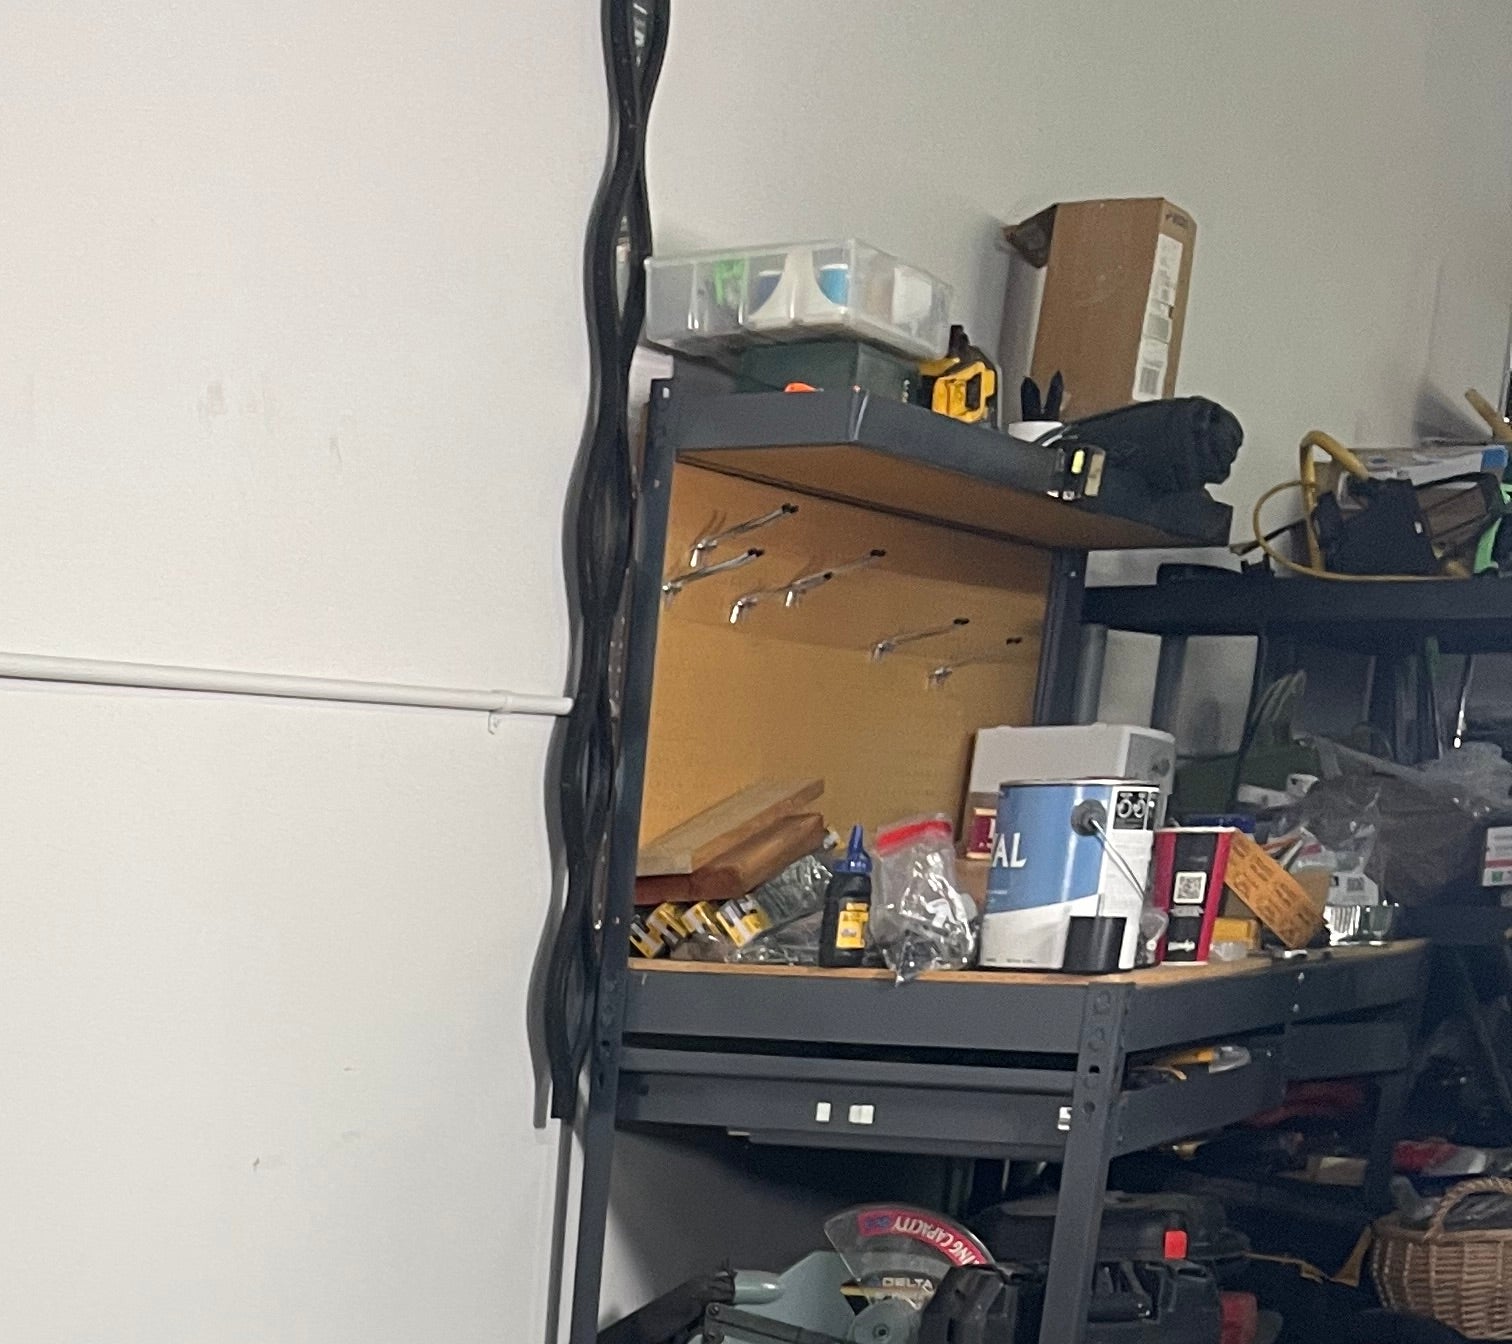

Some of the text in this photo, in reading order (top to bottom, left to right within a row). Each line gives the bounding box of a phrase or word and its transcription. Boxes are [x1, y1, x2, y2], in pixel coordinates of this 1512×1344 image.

[991, 832, 1027, 868] AL
[892, 1215, 955, 1247] CAPACITY
[882, 1277, 935, 1296] DELTA
